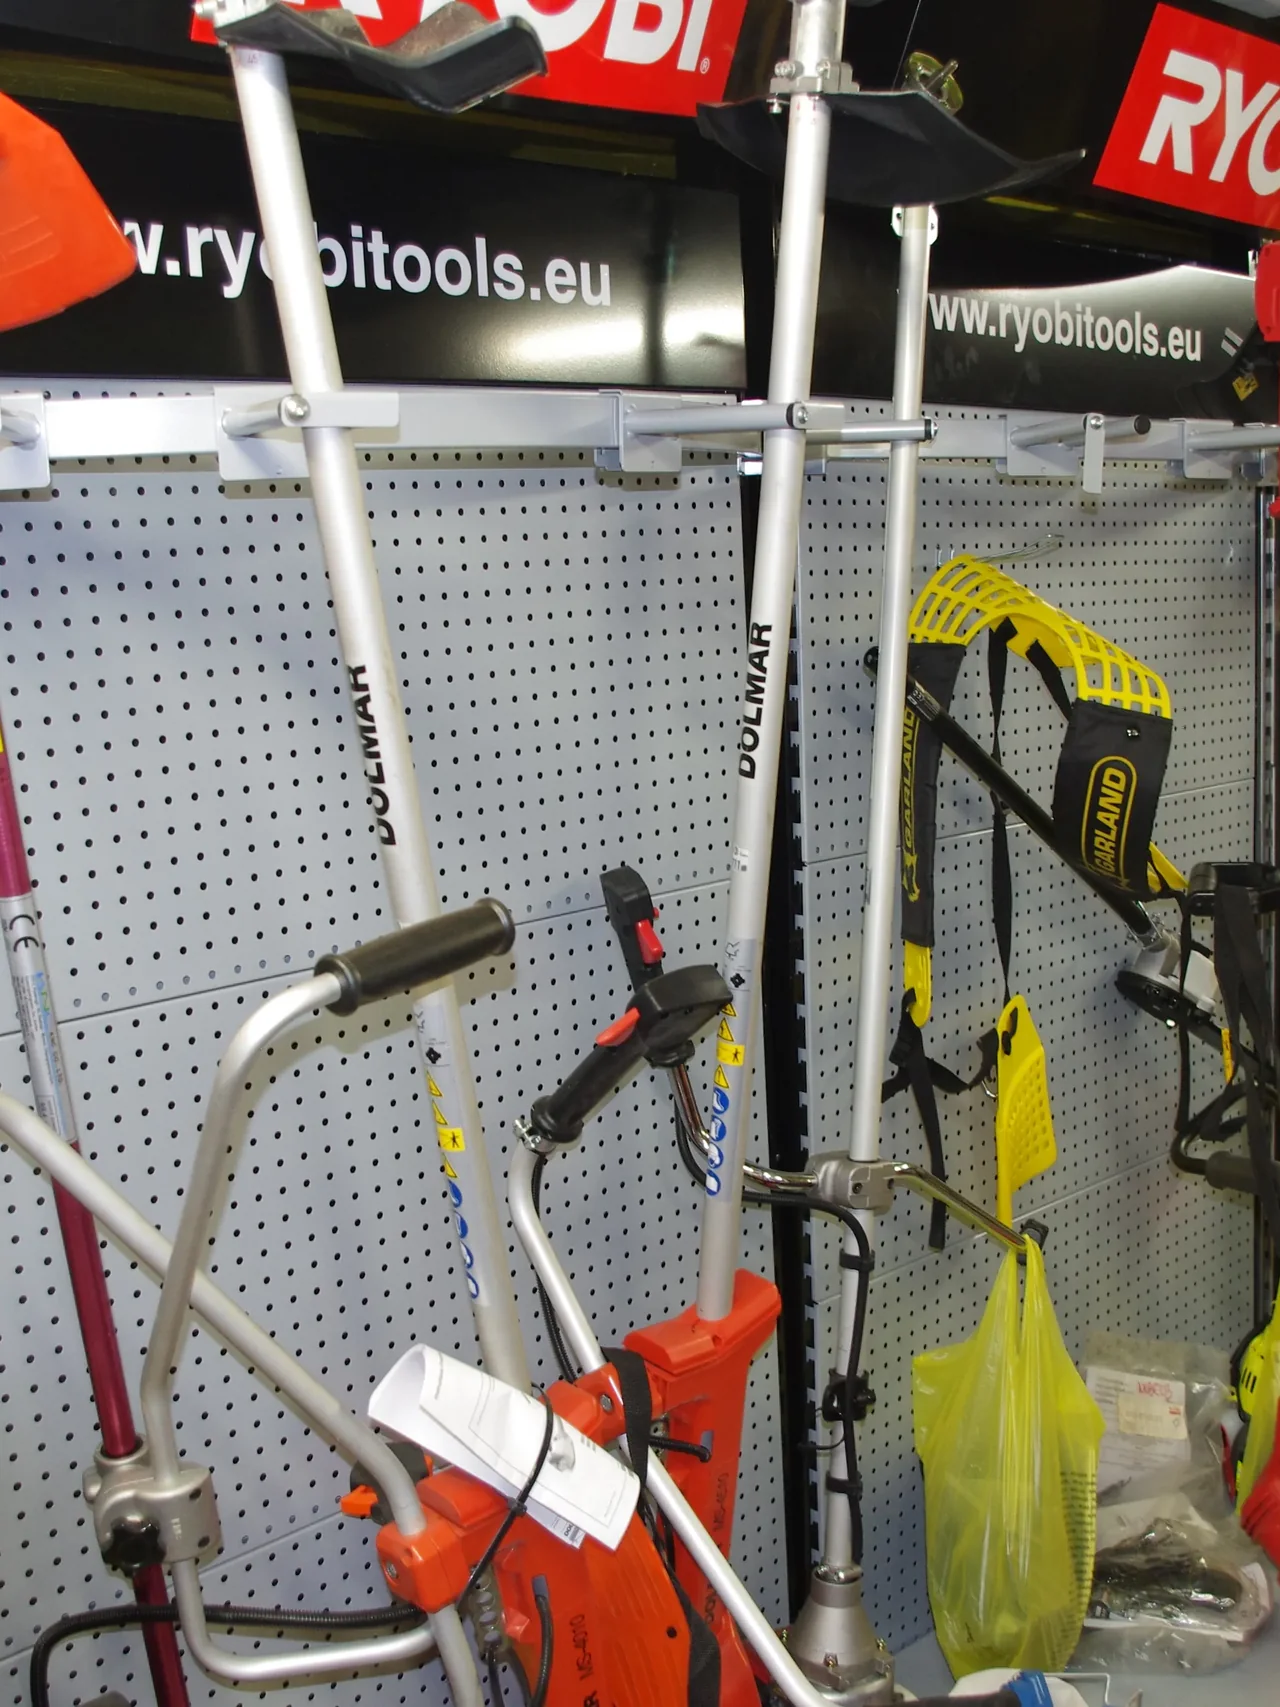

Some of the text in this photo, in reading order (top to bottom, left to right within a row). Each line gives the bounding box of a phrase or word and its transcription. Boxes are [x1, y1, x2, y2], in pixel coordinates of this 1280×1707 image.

[346, 664, 397, 846] DOLMAR
[739, 622, 773, 779] DOLMAR
[1094, 766, 1127, 873] GARLAND
